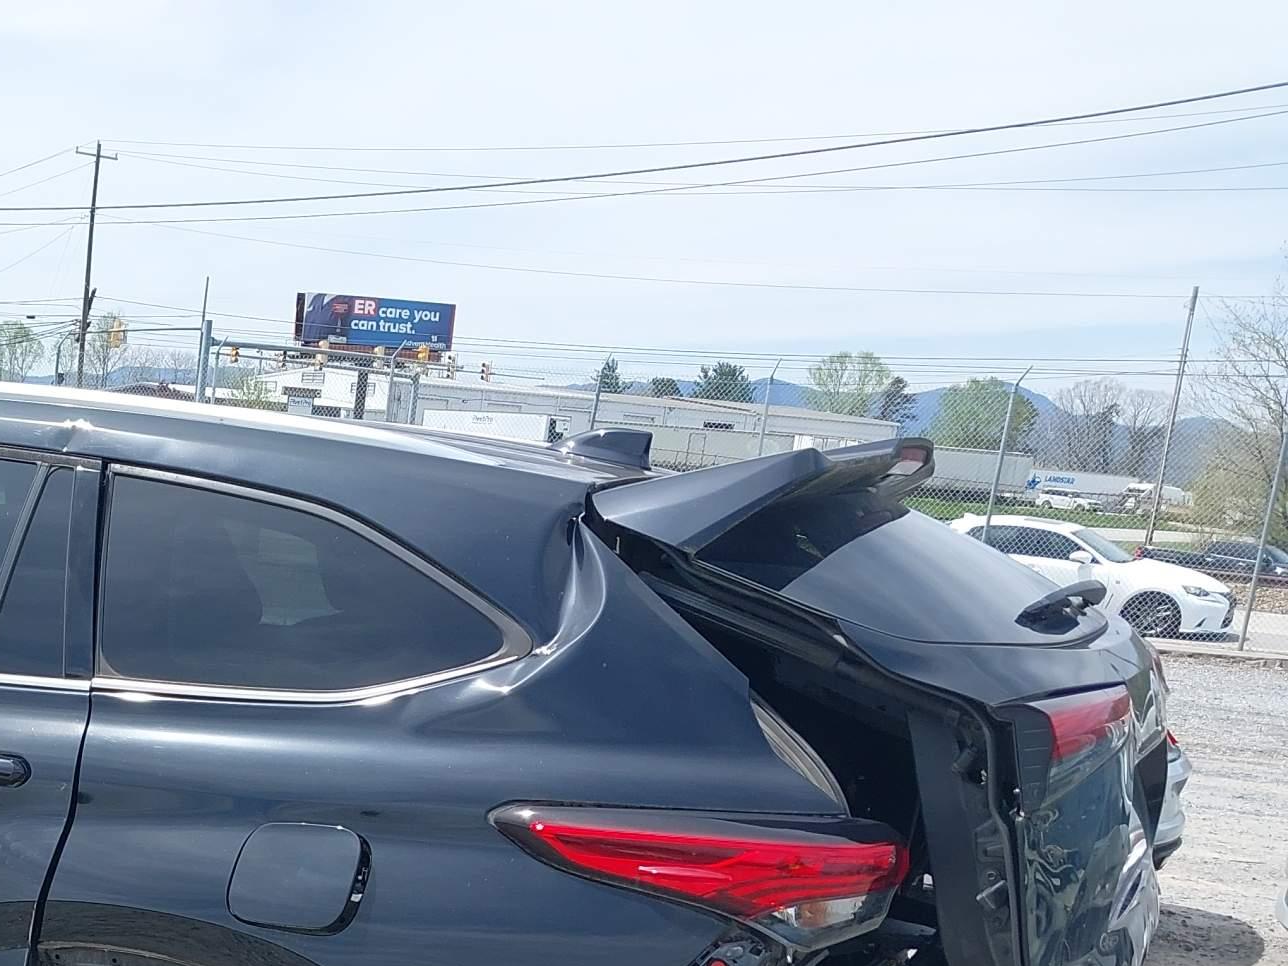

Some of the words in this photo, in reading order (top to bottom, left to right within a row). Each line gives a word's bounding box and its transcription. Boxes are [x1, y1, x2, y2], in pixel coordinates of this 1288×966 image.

[354, 300, 376, 315] ER
[378, 307, 411, 320] care
[413, 310, 441, 323] you
[350, 319, 377, 332] can
[378, 320, 416, 335] trust.
